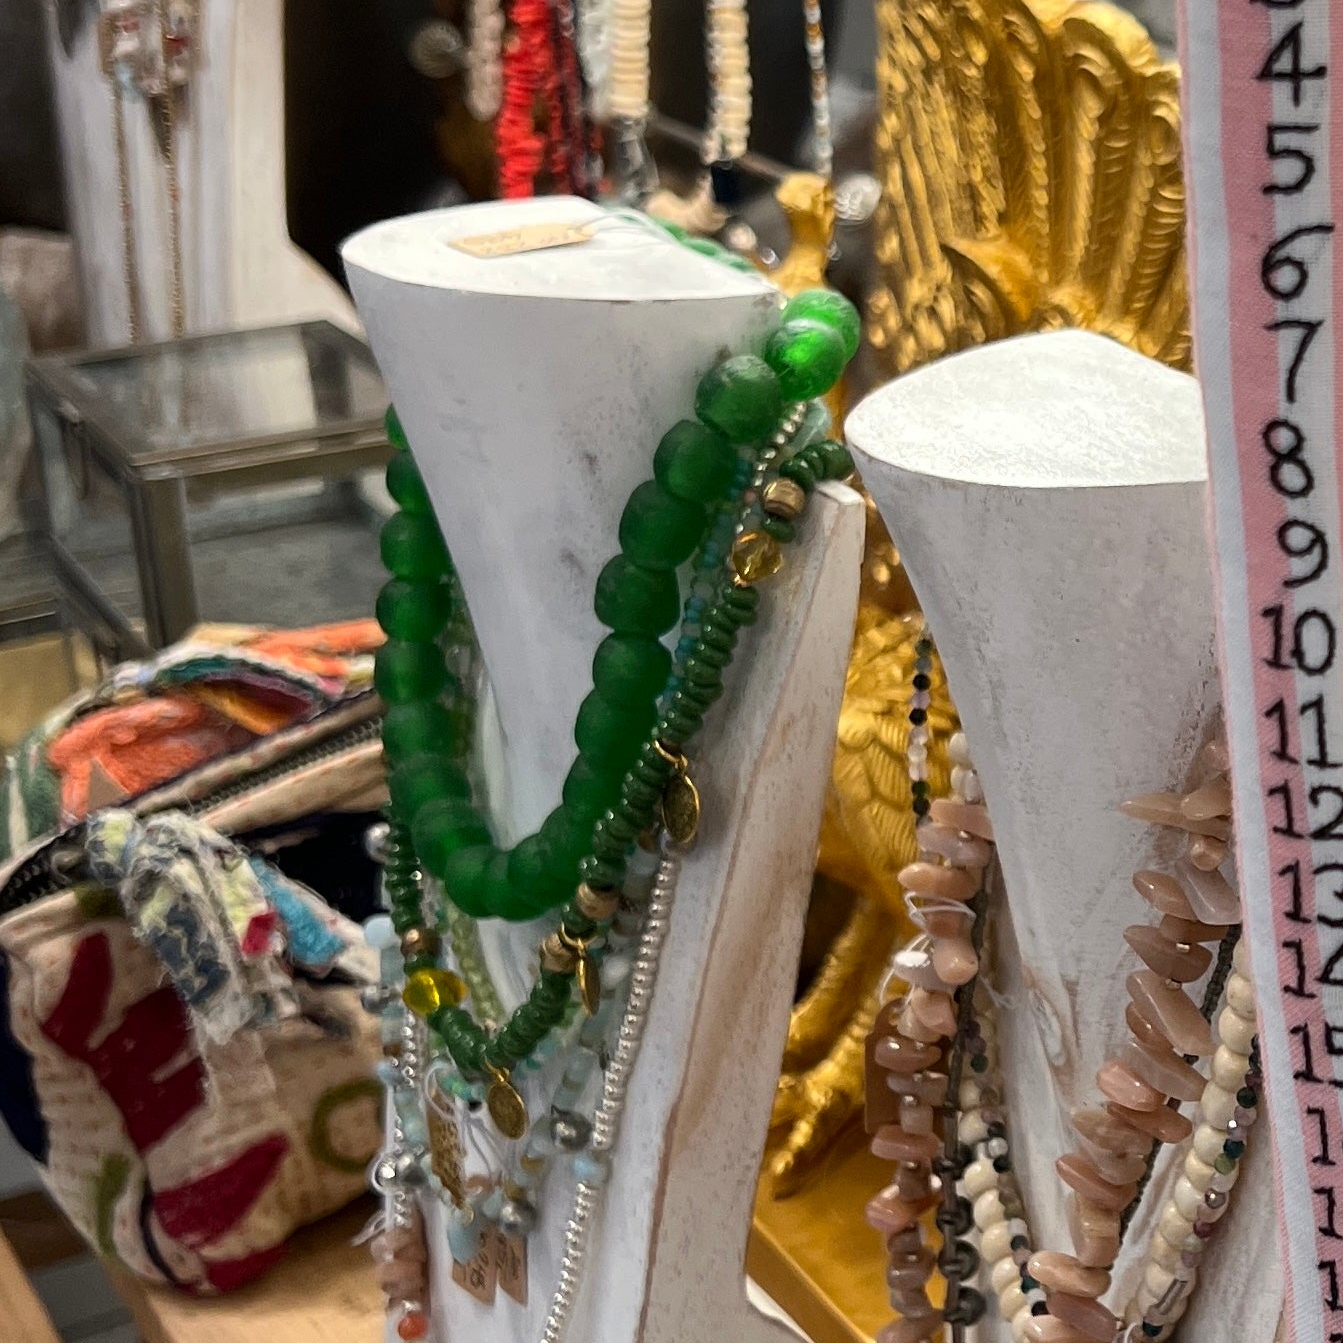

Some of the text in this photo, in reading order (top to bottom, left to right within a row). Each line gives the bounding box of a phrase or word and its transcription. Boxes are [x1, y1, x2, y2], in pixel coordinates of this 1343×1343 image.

[1254, 20, 1328, 108] 4
[1260, 122, 1319, 197] 5
[1260, 222, 1335, 304] 6
[1263, 318, 1324, 405] 7
[1261, 418, 1315, 500] 8
[1275, 518, 1329, 589] 9
[1260, 603, 1337, 677] 10
[1264, 693, 1343, 771] 11
